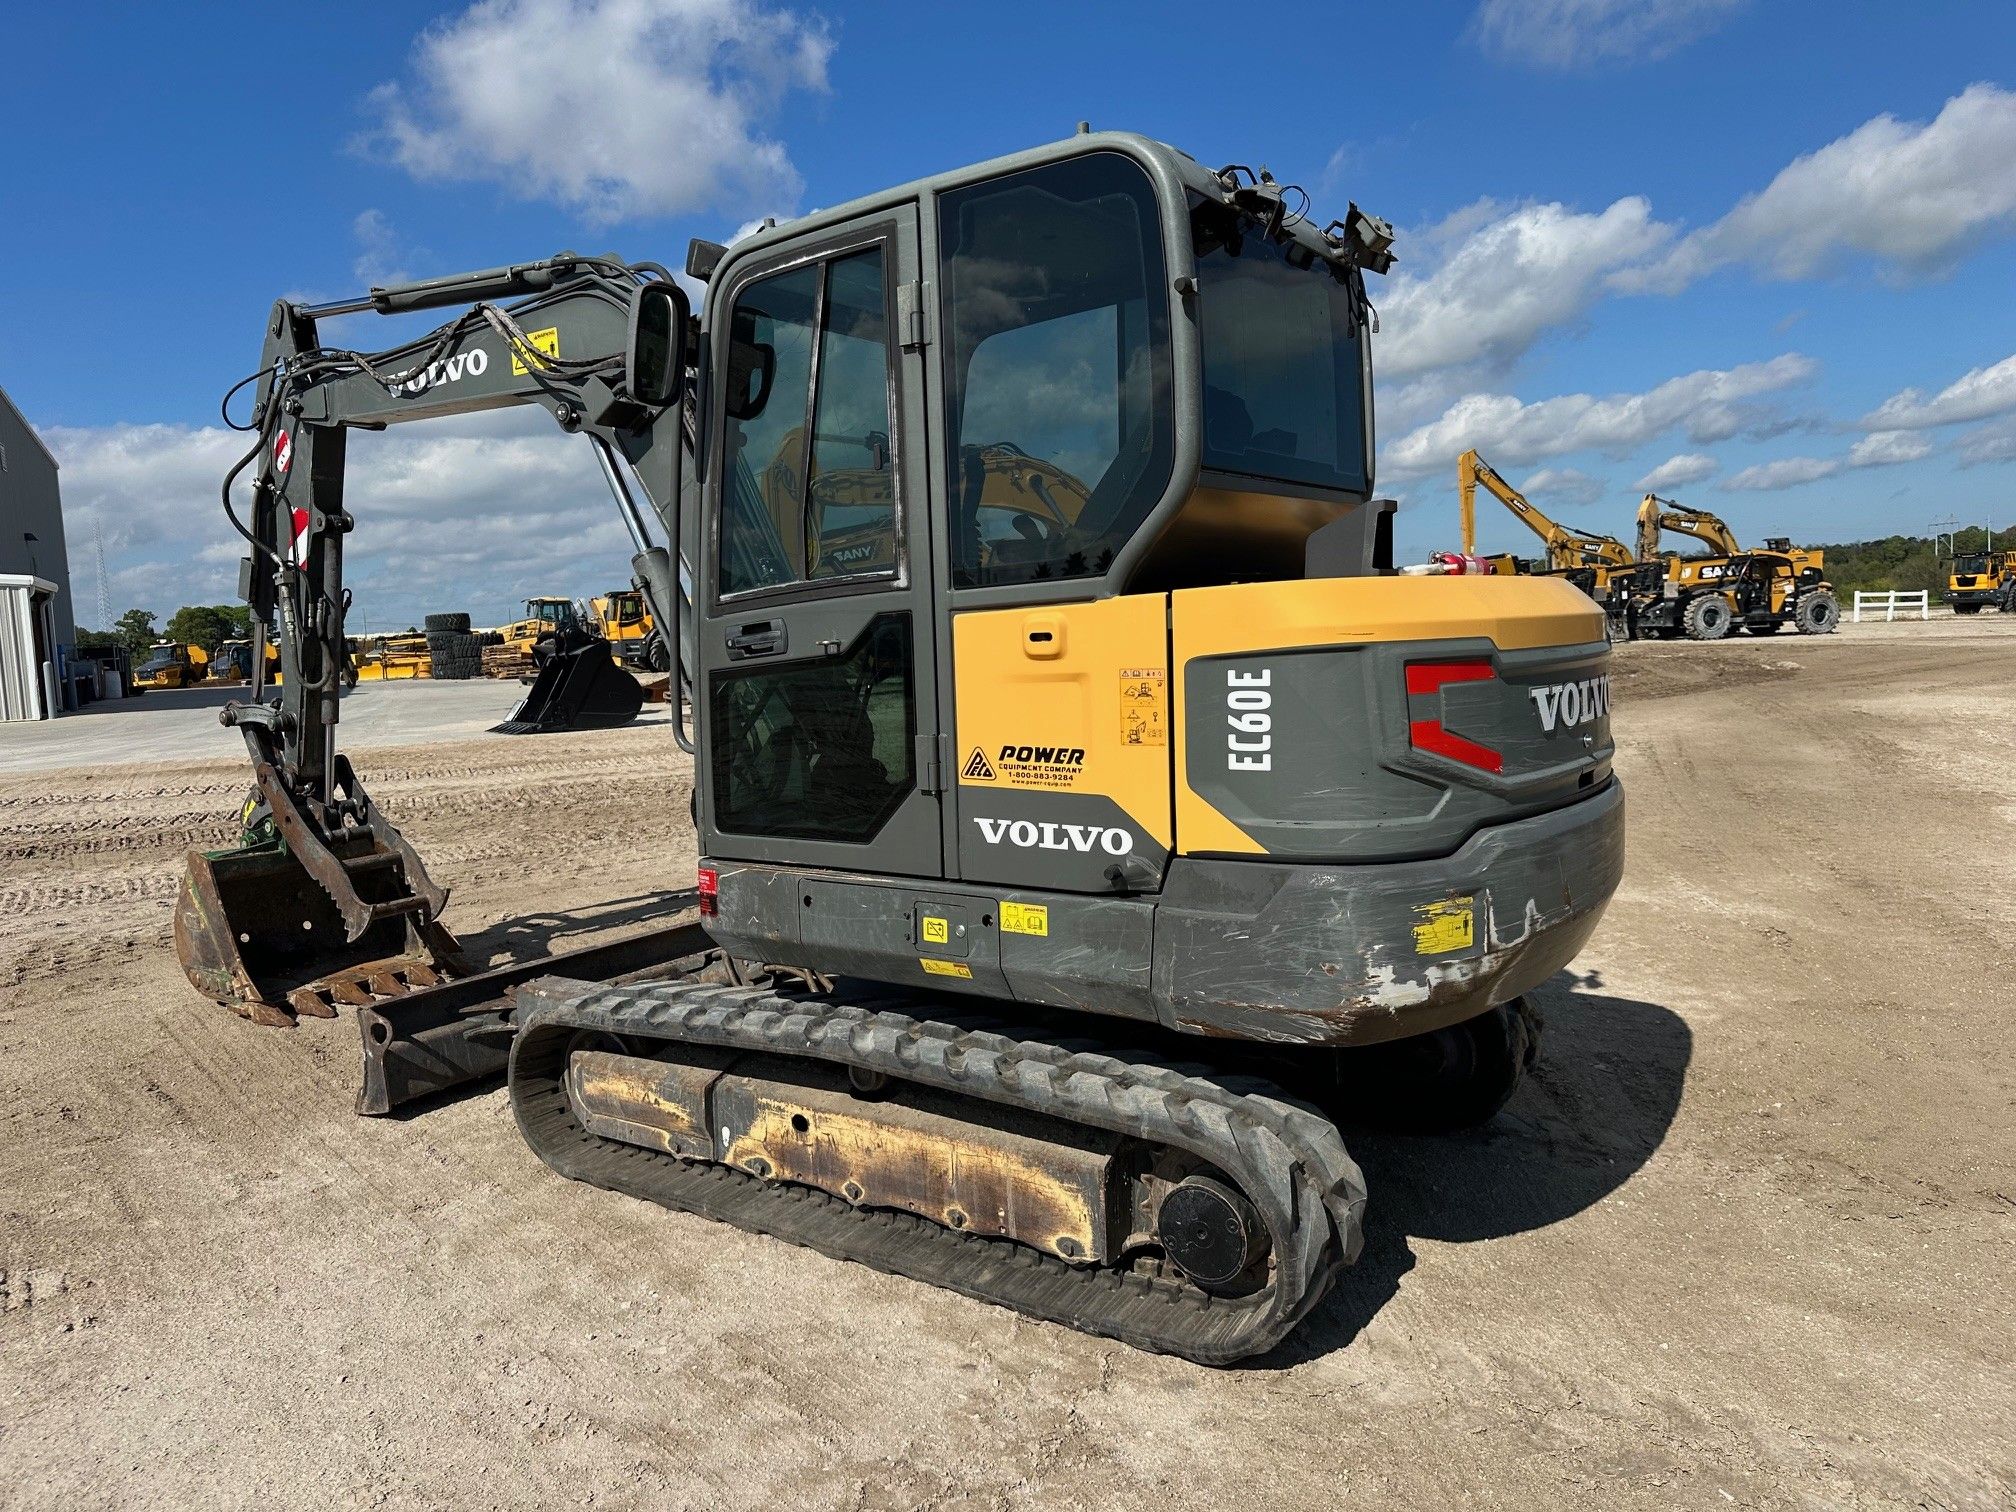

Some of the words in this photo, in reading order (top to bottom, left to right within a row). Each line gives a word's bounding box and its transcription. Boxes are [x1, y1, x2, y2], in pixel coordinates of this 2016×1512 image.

[1227, 668, 1272, 772] EC60E
[998, 745, 1085, 766] POWER
[998, 763, 1043, 773] EQUIPMENT
[1044, 765, 1083, 774] COMPANY
[1008, 771, 1074, 782] 1-800-883-9284
[973, 817, 1134, 856] VOLVO
